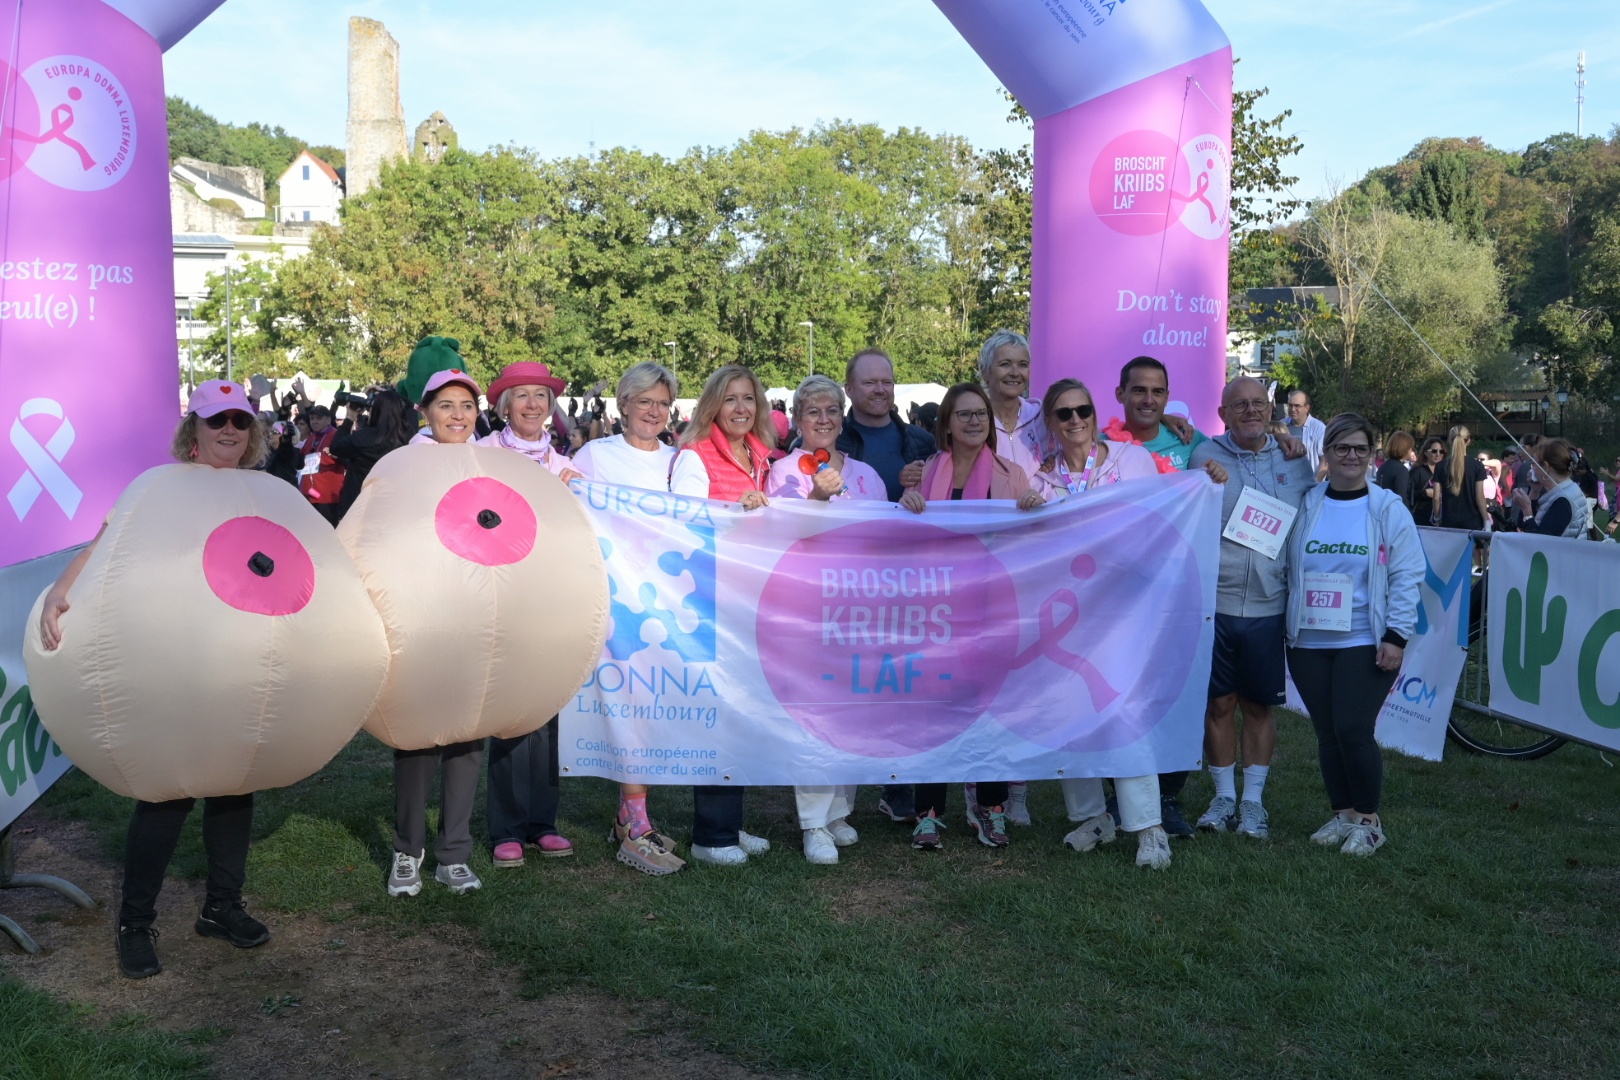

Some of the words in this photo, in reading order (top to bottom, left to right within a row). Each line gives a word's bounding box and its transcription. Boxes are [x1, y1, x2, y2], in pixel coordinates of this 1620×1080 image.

[44, 64, 91, 79] EUROPA
[94, 72, 123, 107] DONNA
[104, 110, 131, 176] LUXEMBOURG
[1114, 156, 1167, 172] BROSCHT
[1114, 173, 1165, 193] KRIIBS
[1113, 194, 1136, 210] LAF
[0, 257, 79, 282] estez
[87, 263, 134, 290] pas
[0, 293, 79, 328] eul(e)
[1116, 288, 1184, 312] Don't
[1189, 294, 1222, 322] stay
[1142, 323, 1208, 347] alone!
[1247, 509, 1279, 532] 1377
[1305, 540, 1369, 556] Cactus
[821, 566, 954, 598] BROSCHT
[1311, 591, 1335, 607] 257
[821, 604, 953, 646] KRIIBS
[851, 653, 925, 694] LAF
[575, 694, 718, 729] Luxembourg
[575, 738, 628, 758] Coalition
[631, 746, 717, 761] européenne
[575, 757, 613, 770] contre
[614, 761, 623, 773] le
[625, 762, 668, 775] cancer
[672, 762, 688, 776] du
[691, 763, 717, 776] sein
